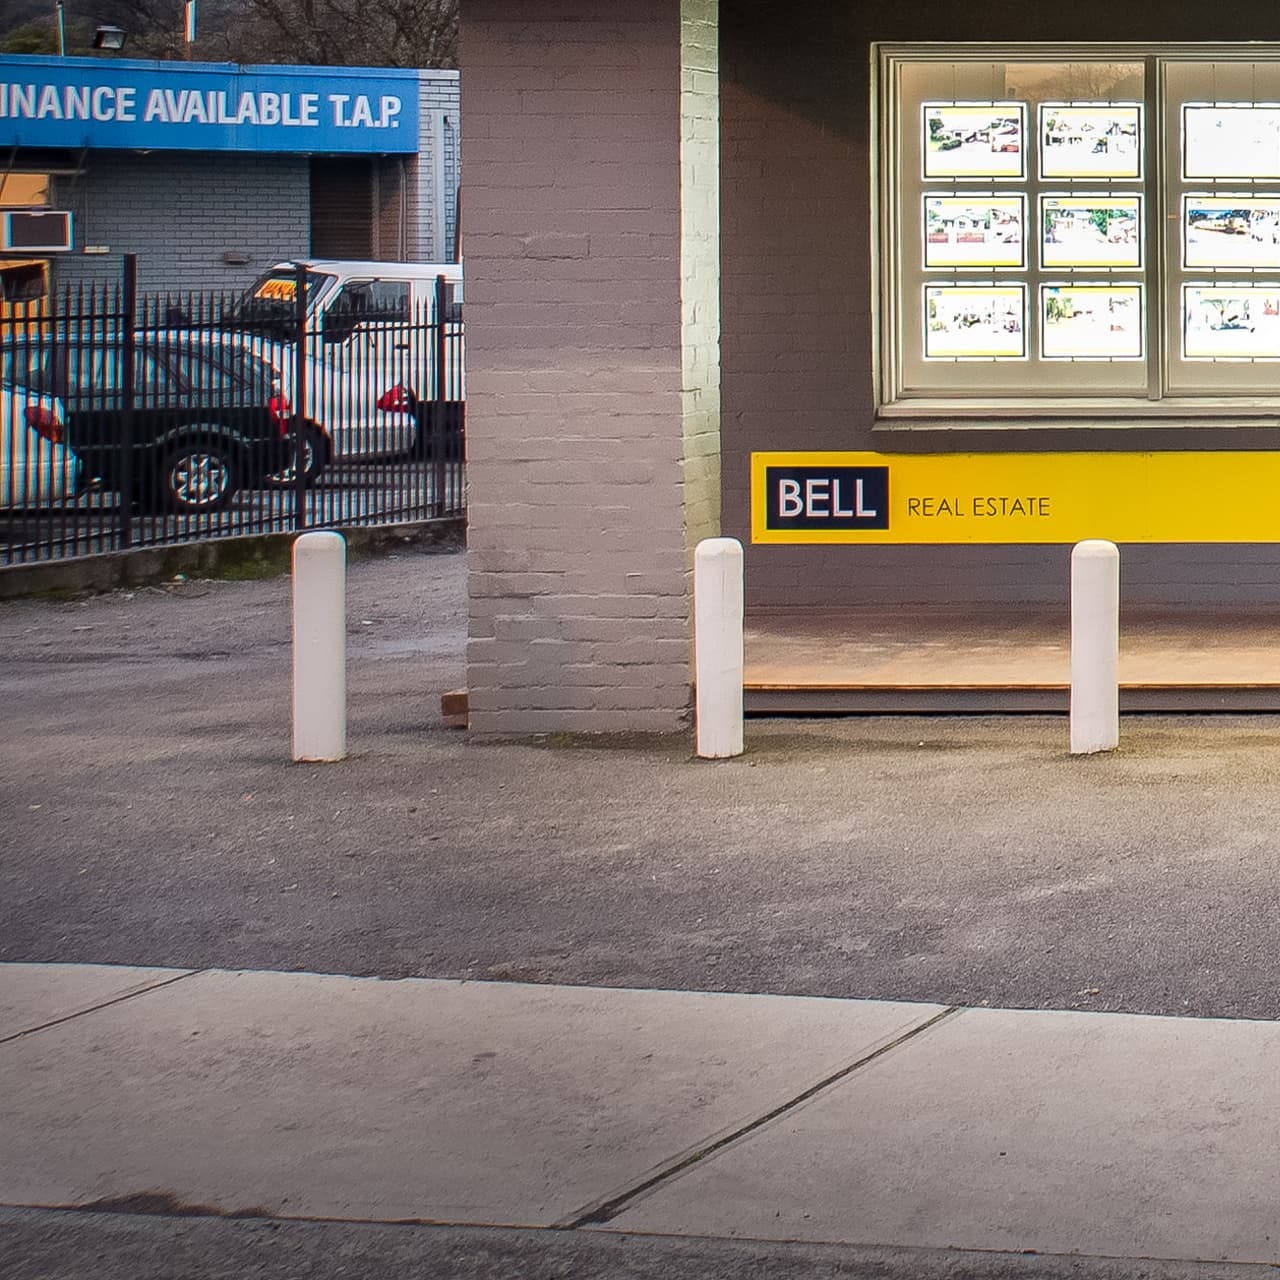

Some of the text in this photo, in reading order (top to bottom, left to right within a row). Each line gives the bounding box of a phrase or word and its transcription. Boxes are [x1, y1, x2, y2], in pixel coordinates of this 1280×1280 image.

[143, 87, 319, 127] AVAILABLE
[328, 93, 401, 129] T.A.P.
[778, 478, 1051, 518] BELL REAL ESTATE
